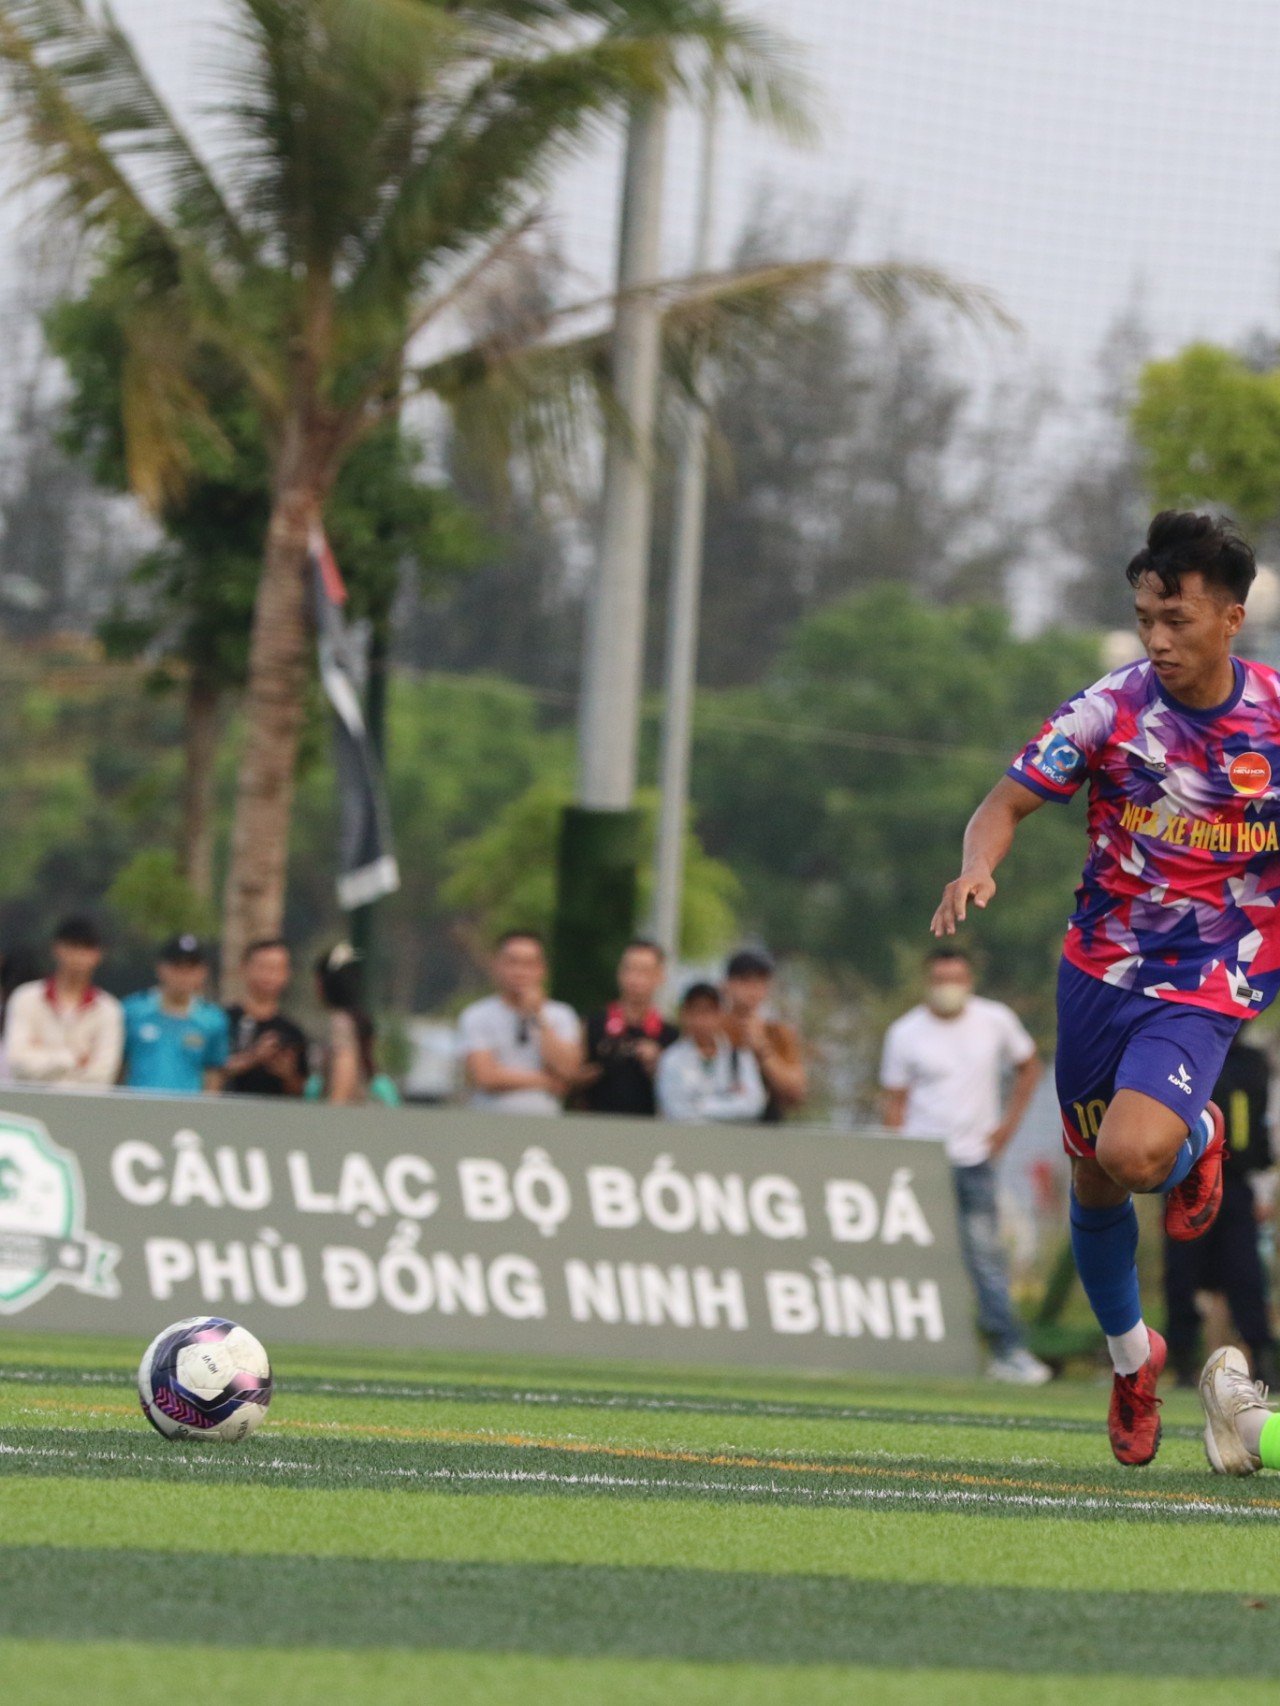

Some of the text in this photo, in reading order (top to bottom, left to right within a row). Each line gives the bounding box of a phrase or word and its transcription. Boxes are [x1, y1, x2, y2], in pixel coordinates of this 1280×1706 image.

[1161, 817, 1188, 845] XE
[1237, 821, 1279, 852] HOA
[1073, 1099, 1107, 1139] 10
[111, 1128, 934, 1247] CÂU LẠC BỘ BÓNG ĐÁ
[144, 1227, 307, 1307] PHÙ
[564, 1258, 749, 1330] NINH
[765, 1258, 946, 1342] BÌNH
